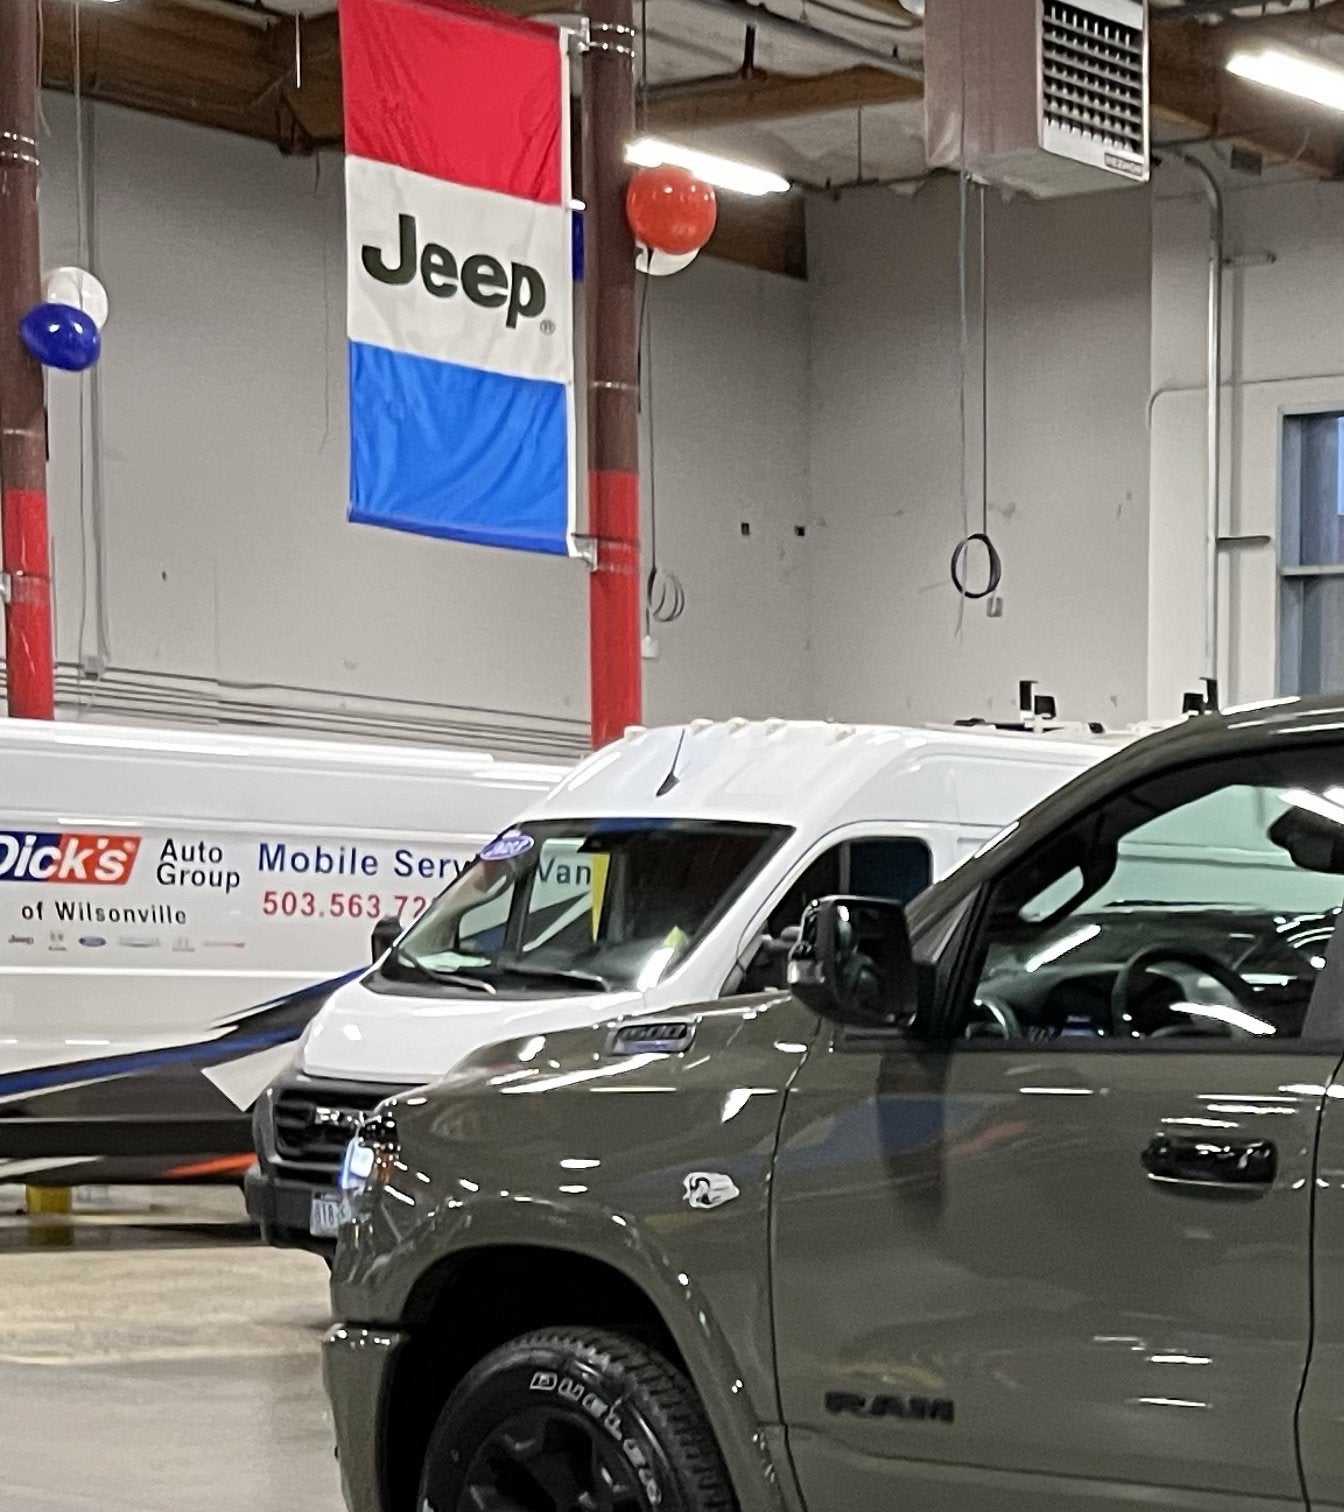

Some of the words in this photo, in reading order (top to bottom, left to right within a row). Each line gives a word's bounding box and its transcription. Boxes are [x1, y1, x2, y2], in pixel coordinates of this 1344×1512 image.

[361, 212, 547, 330] Jeep
[160, 838, 223, 864] Auto
[258, 842, 379, 876] Mobile
[394, 849, 469, 880] Serv
[156, 862, 241, 894] Group
[21, 901, 44, 921] of
[54, 900, 187, 925] Wilsonville
